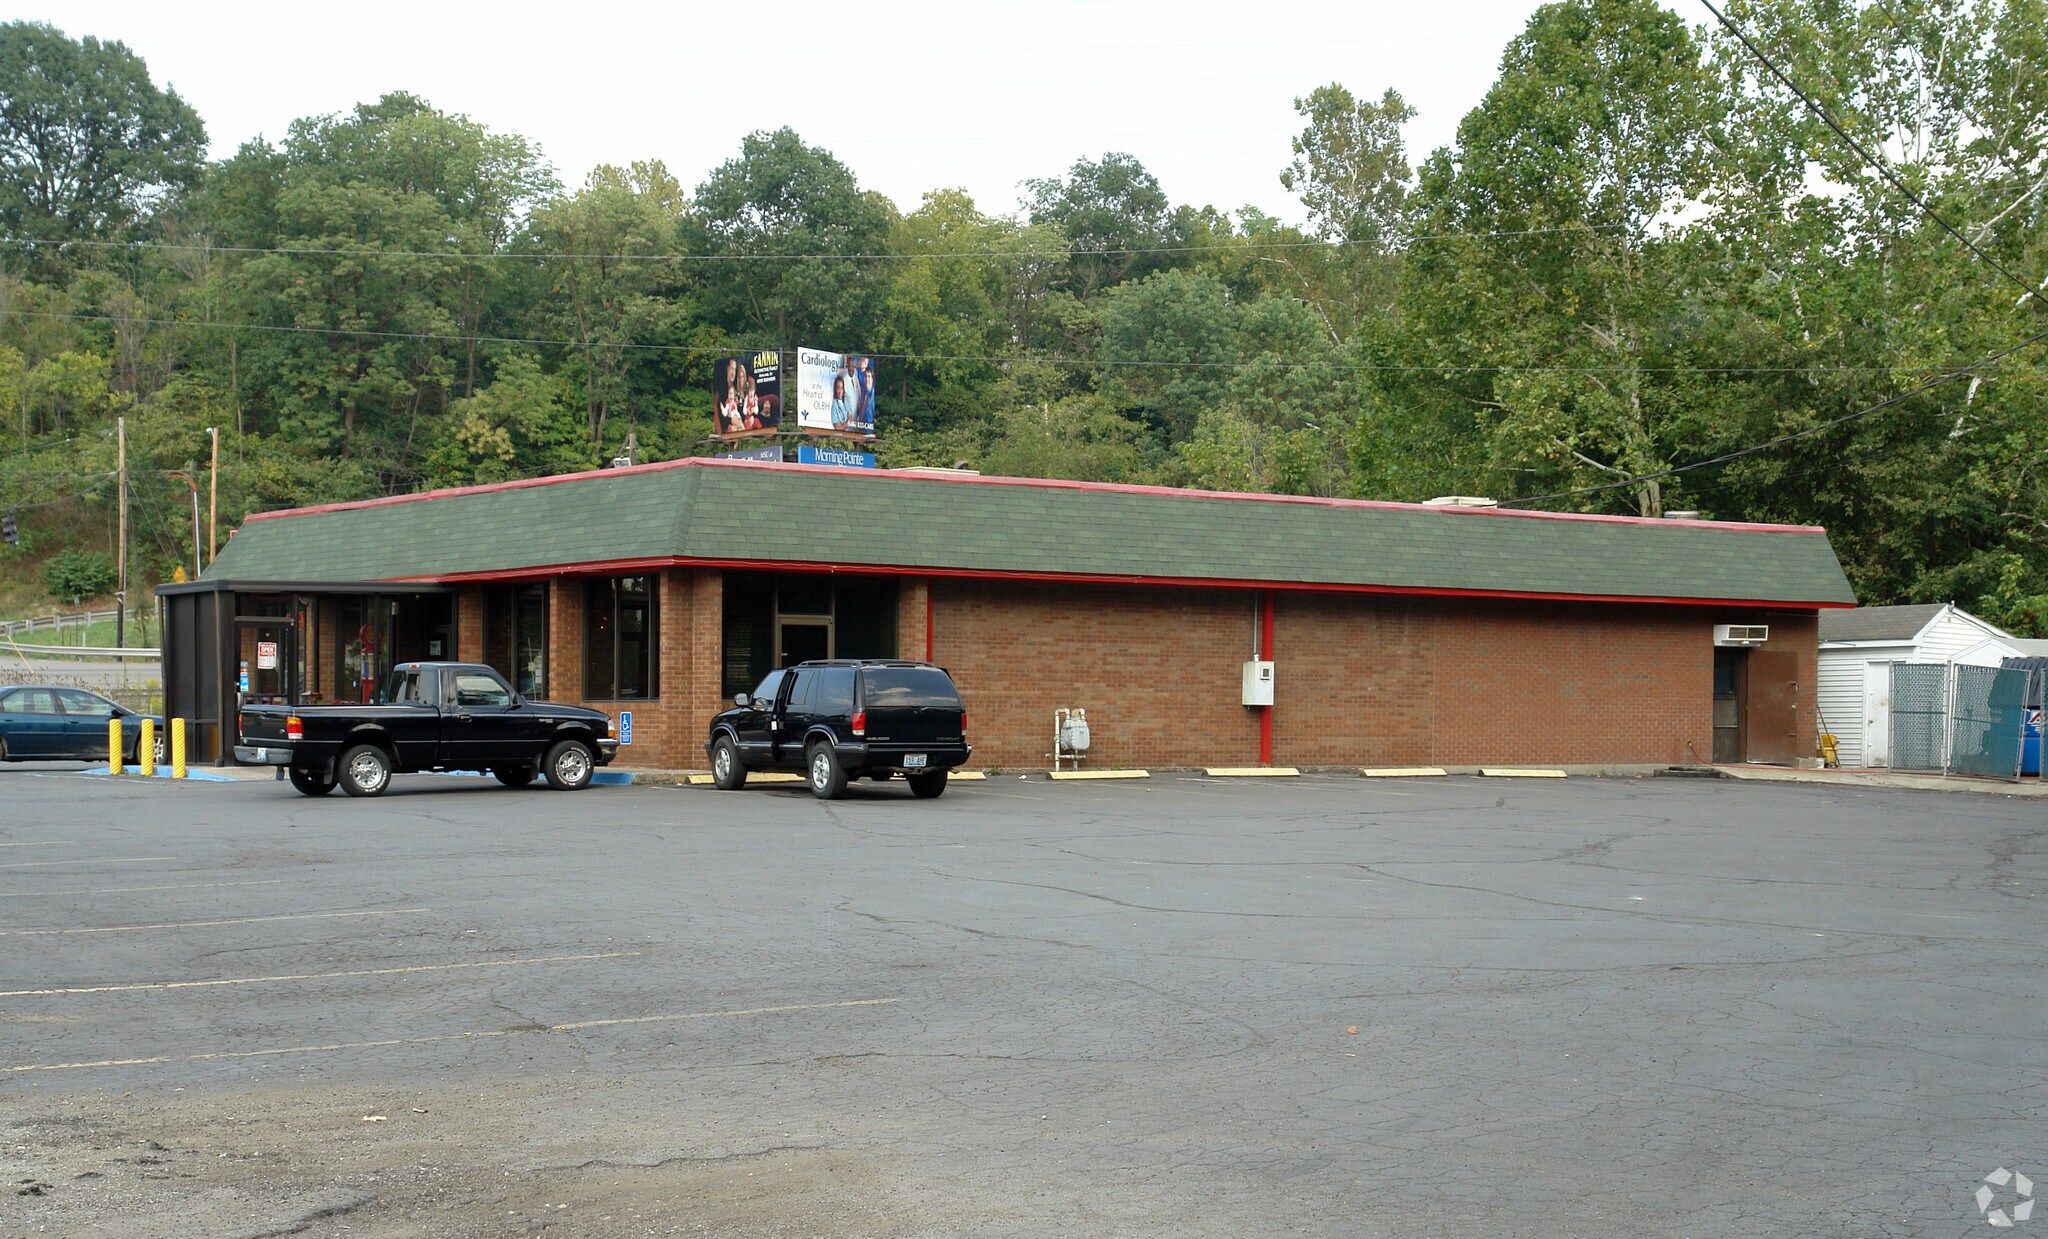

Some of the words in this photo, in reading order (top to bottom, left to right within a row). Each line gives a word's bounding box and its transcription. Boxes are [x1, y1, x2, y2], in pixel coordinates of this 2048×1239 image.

[753, 351, 779, 368] FANNIN
[801, 352, 840, 372] Cardiology
[815, 448, 843, 467] Morning
[844, 450, 864, 465] Pointe
